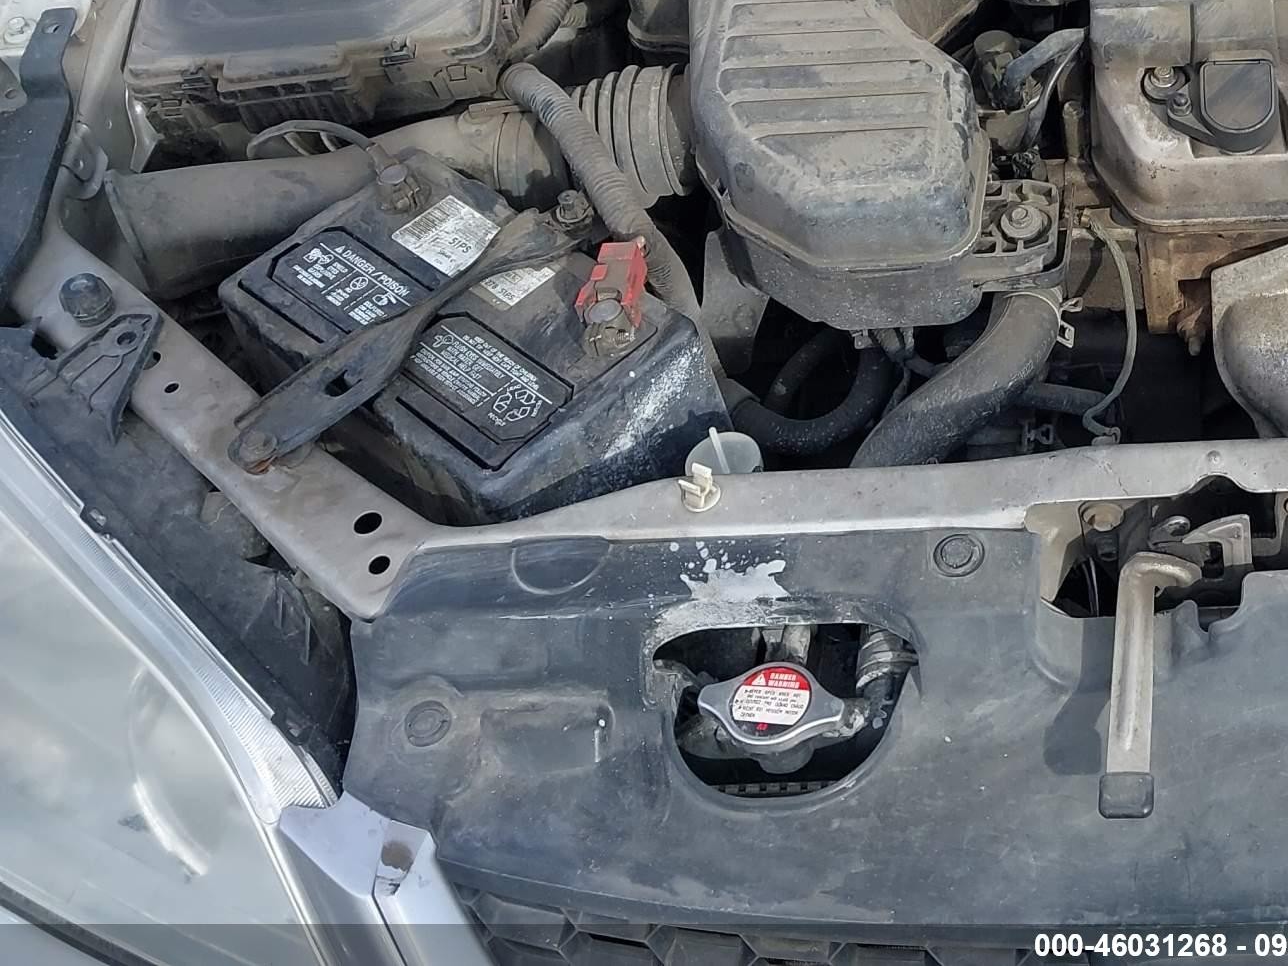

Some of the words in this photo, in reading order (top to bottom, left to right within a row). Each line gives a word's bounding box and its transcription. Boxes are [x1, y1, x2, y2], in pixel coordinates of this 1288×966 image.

[341, 249, 376, 274] DANGER
[378, 274, 410, 298] POISON
[767, 679, 800, 689] WARNING
